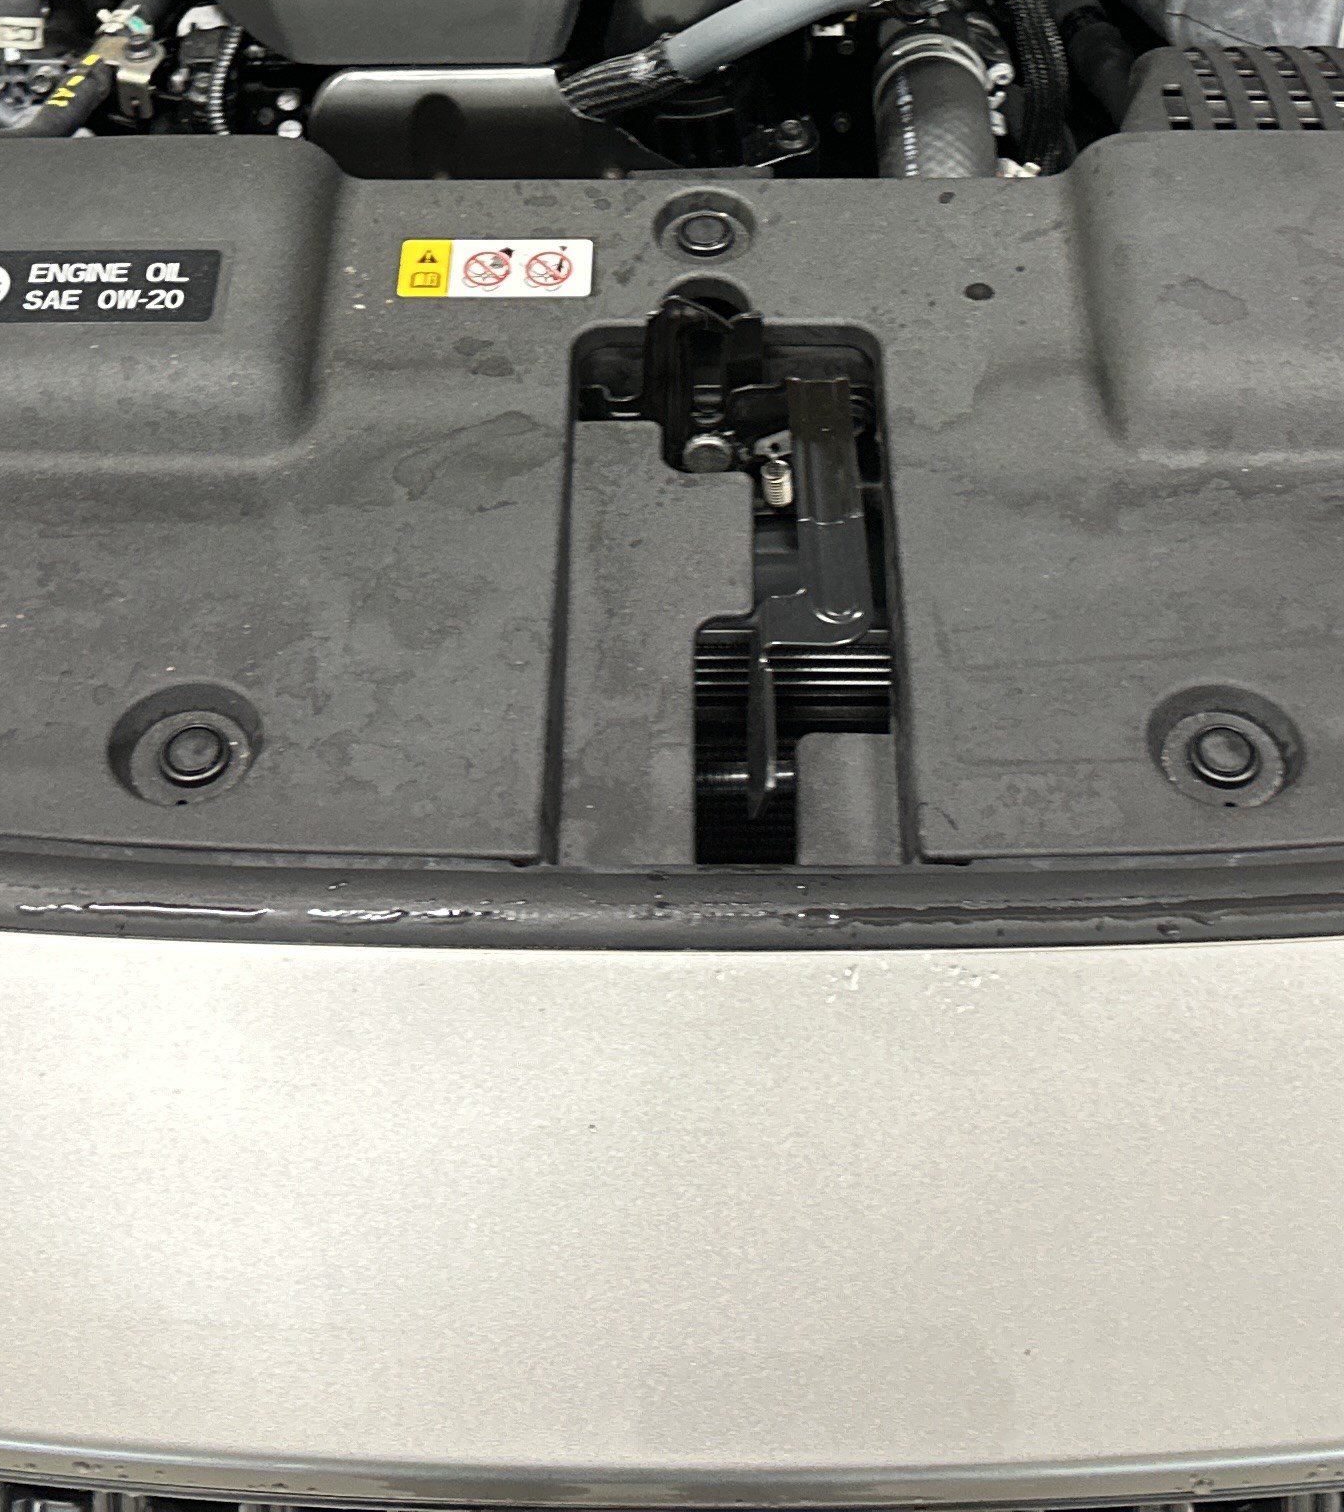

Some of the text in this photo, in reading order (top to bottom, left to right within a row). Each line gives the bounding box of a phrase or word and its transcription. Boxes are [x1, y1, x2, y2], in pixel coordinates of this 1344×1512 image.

[27, 262, 190, 284] ENGINE OIL
[22, 288, 186, 311] SAE 0W-20
